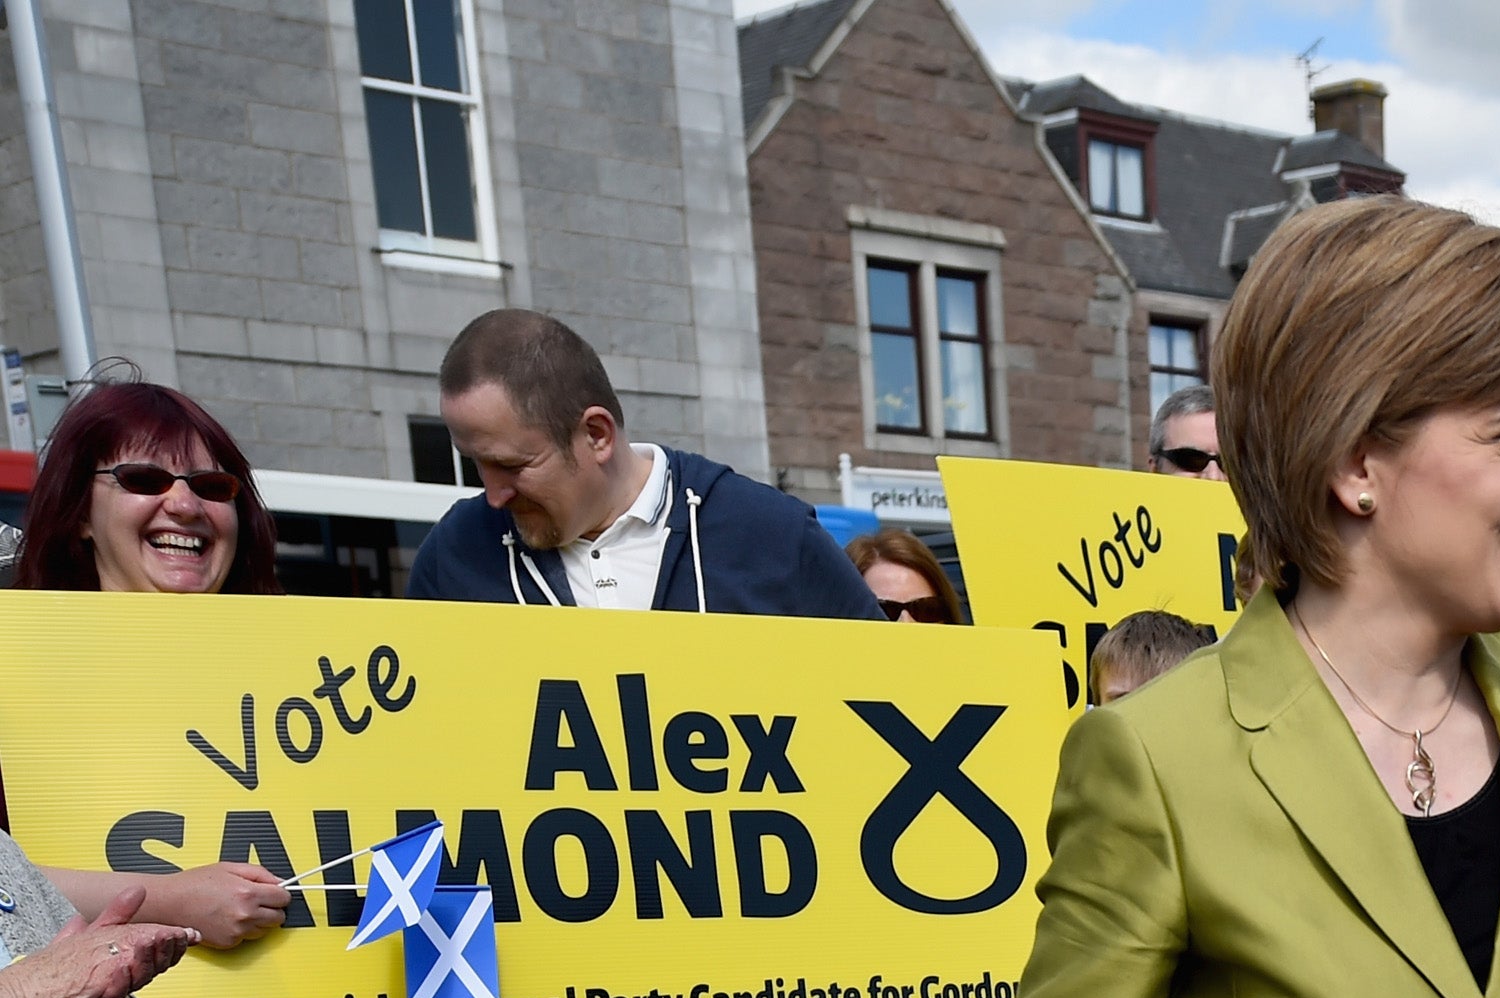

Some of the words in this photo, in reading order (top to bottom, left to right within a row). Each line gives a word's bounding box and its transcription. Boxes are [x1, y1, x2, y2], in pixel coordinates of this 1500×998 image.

[1057, 505, 1161, 607] Vote
[186, 645, 416, 790] Vote
[524, 673, 806, 793] Alex
